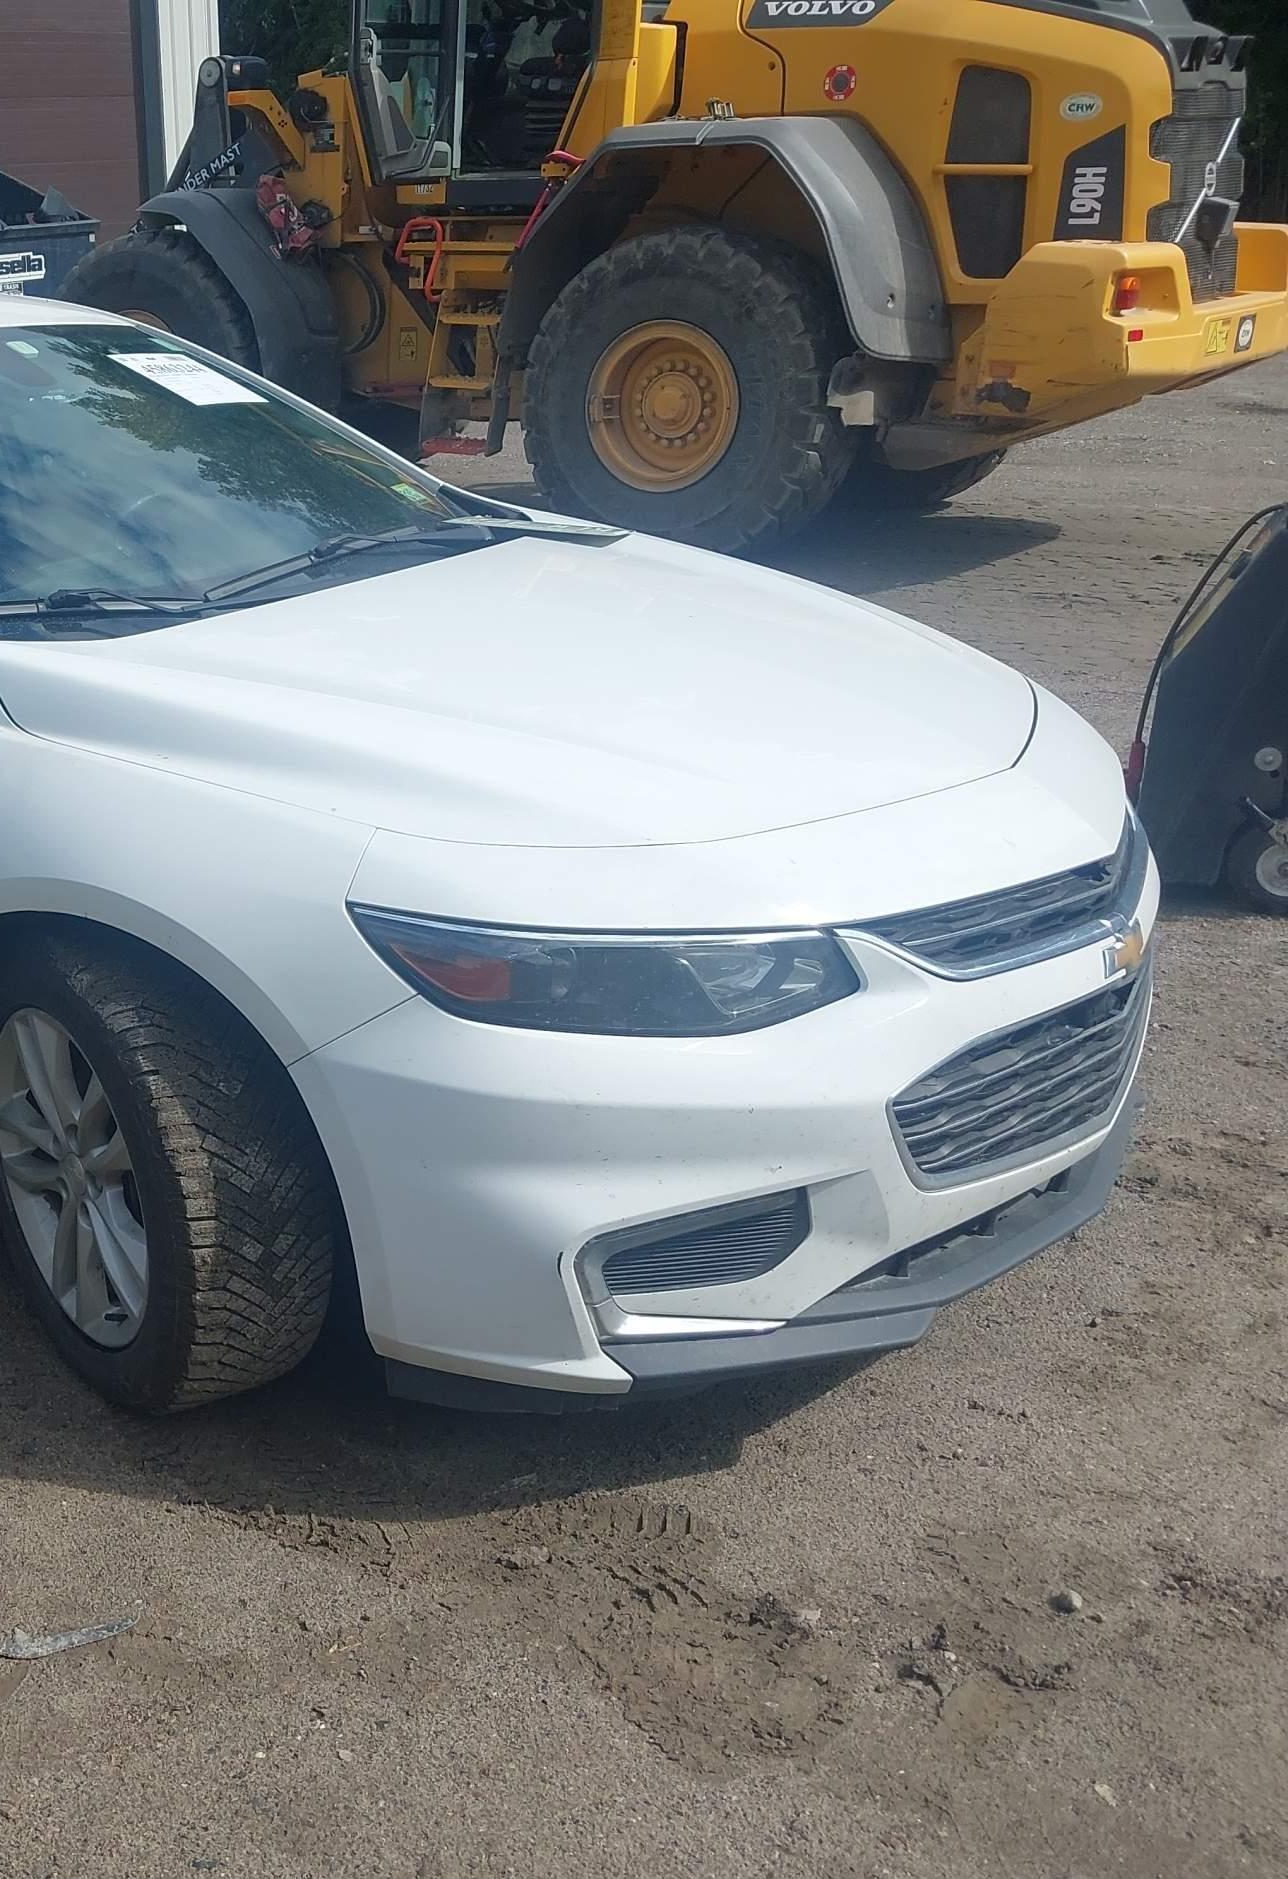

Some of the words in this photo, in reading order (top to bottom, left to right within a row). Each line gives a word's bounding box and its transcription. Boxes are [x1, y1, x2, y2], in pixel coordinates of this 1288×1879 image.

[764, 0, 876, 16] VOLVO
[209, 142, 241, 173] MAST
[1067, 166, 1108, 225] L90H
